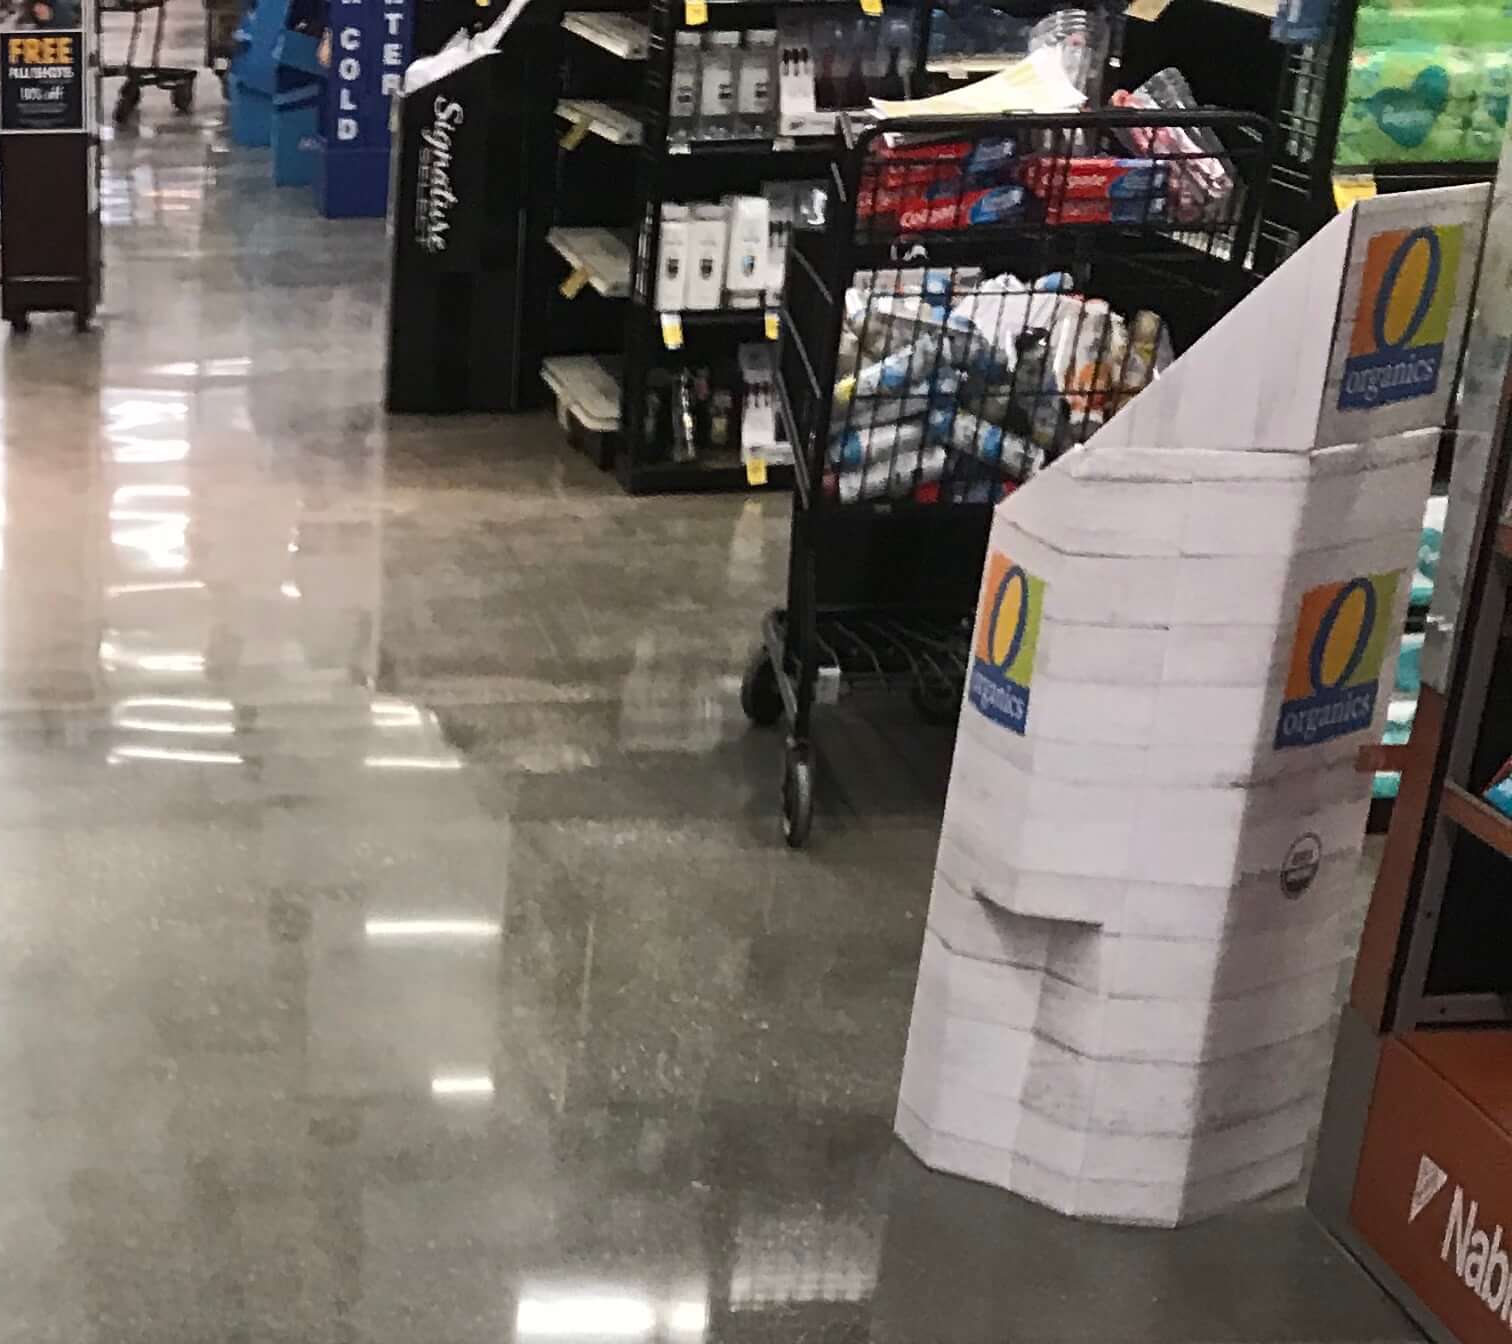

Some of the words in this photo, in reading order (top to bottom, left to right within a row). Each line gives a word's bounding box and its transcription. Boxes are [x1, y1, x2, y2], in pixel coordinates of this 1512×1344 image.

[8, 37, 73, 64] FREE
[338, 26, 361, 141] COLD
[421, 95, 464, 252] Signature
[1345, 353, 1436, 401] organics
[1282, 692, 1371, 741] organics
